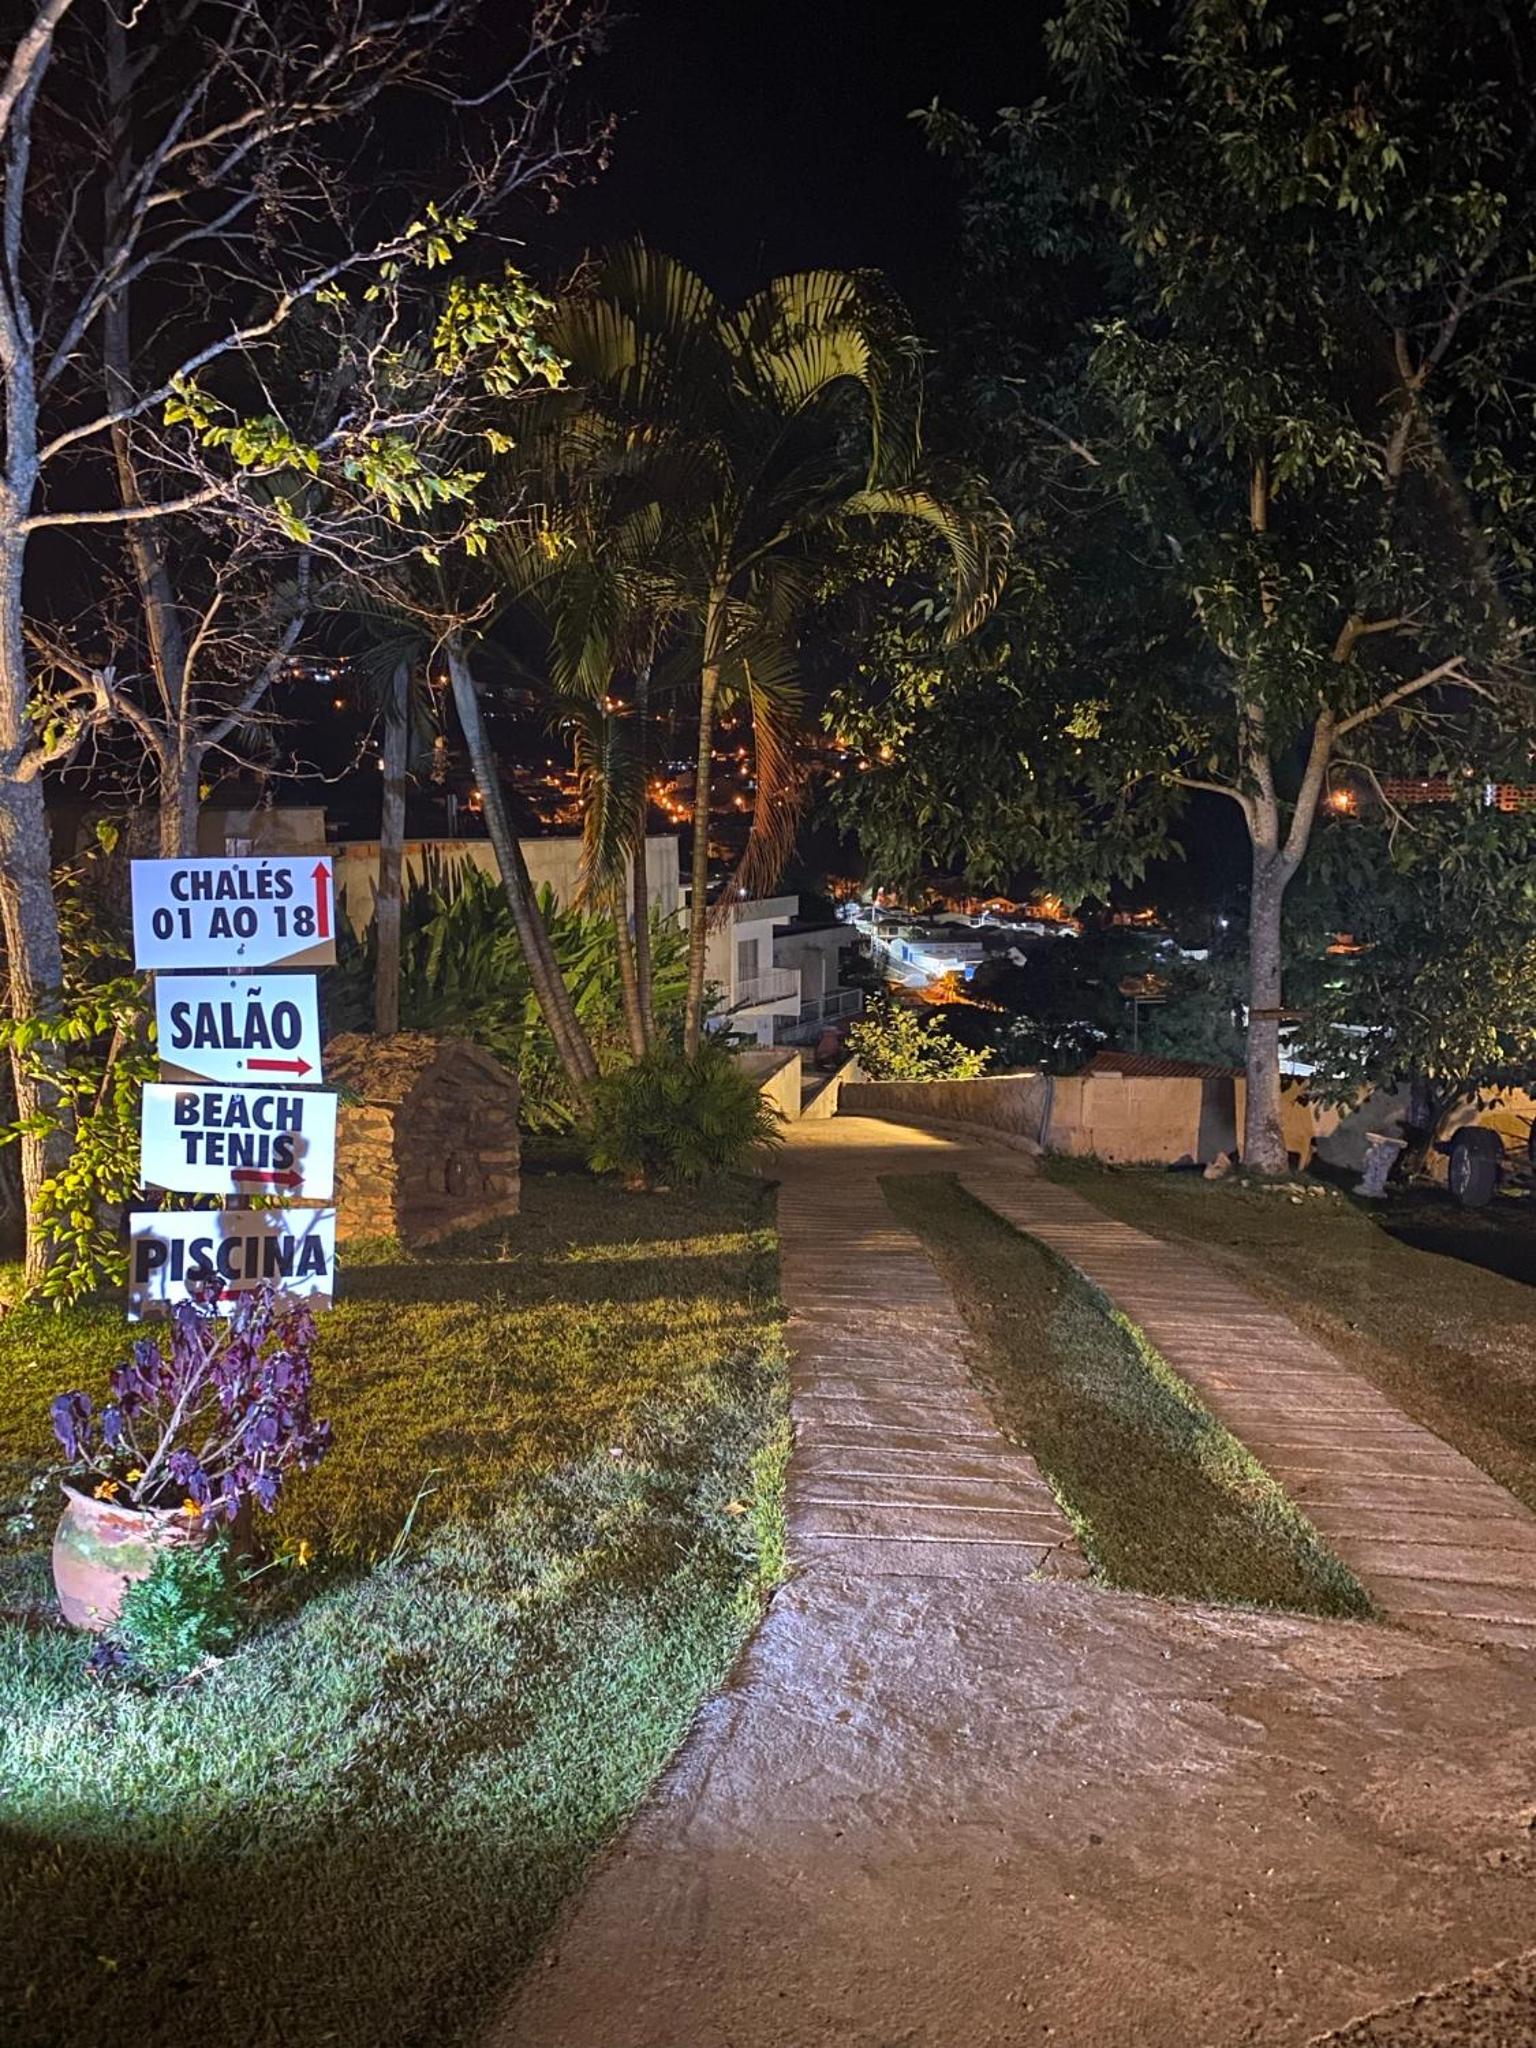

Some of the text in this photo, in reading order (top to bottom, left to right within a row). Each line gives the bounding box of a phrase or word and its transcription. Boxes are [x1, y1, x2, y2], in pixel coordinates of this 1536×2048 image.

[170, 861, 293, 901] CHALÉS
[152, 905, 316, 939] 01 AO 18
[170, 986, 302, 1050] SALÃO
[174, 1092, 304, 1132] BEACH
[180, 1131, 294, 1169] TENIS
[135, 1235, 328, 1283] PISCINA
